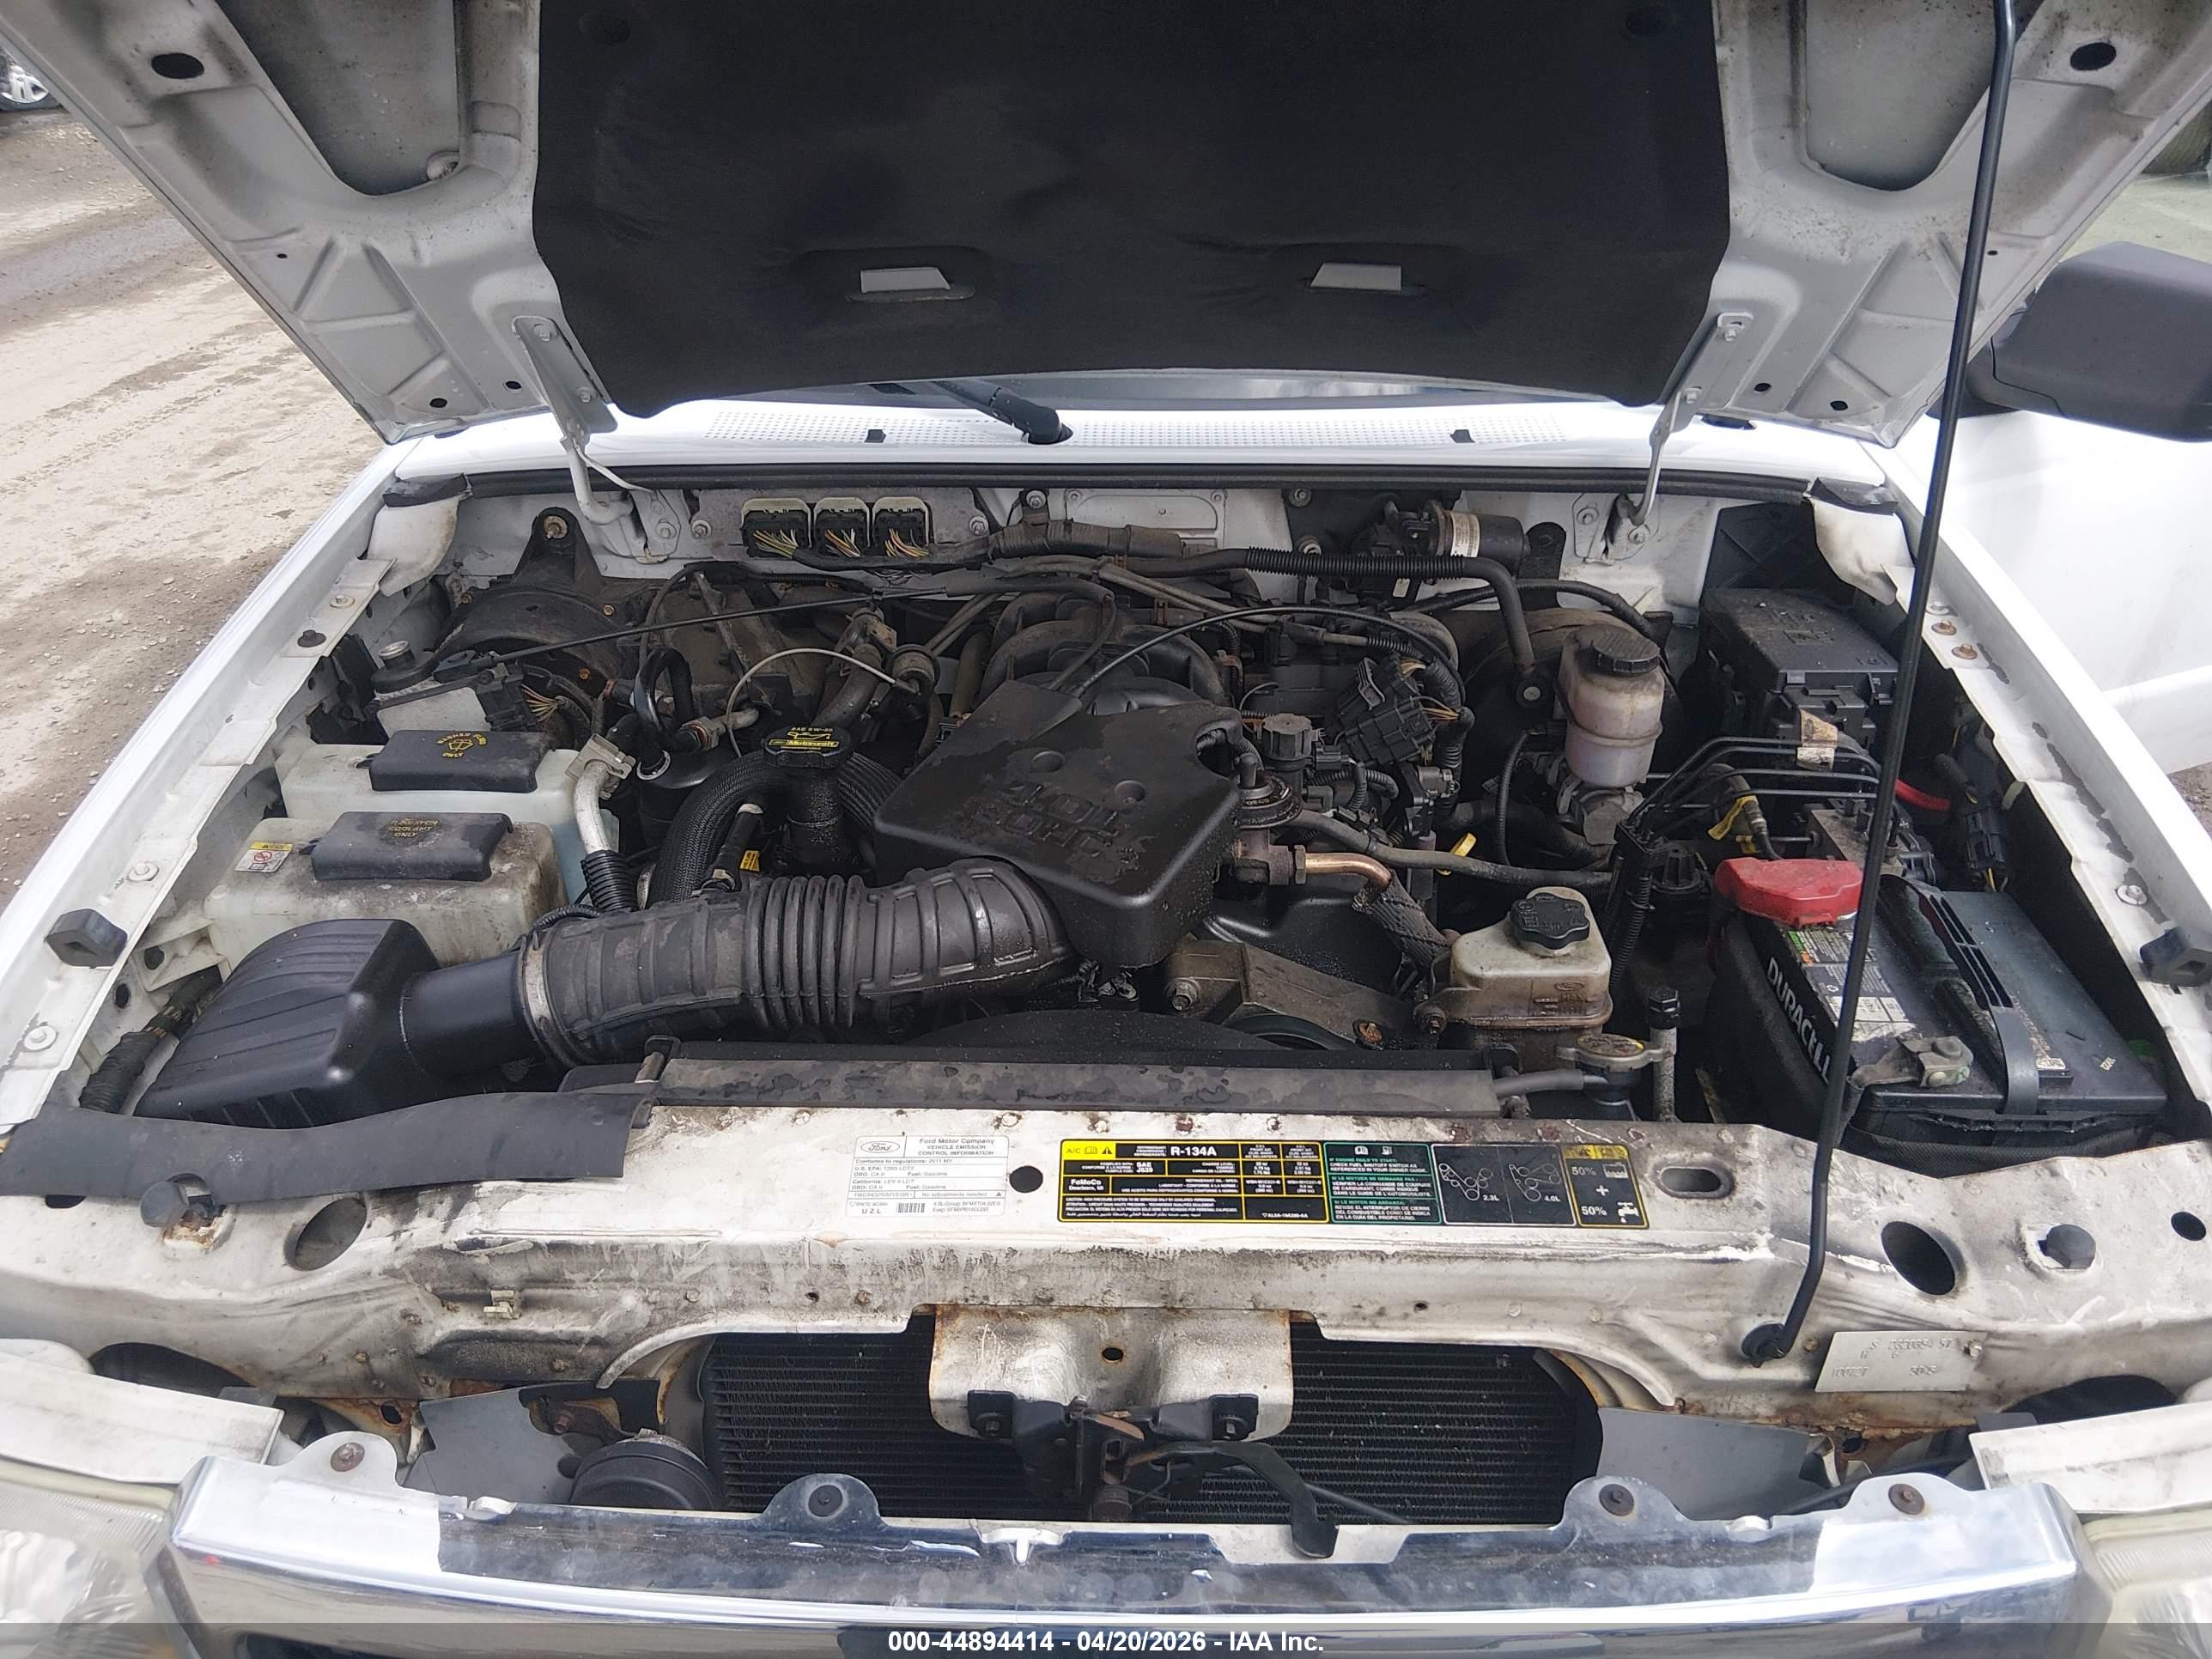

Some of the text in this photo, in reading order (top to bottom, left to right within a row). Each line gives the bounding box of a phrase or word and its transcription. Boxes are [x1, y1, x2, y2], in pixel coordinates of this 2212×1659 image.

[1767, 957, 1831, 1085] DURACELL
[868, 1143, 892, 1151] Ford
[1170, 1146, 1217, 1156] R-134A
[1571, 1167, 1597, 1176] 50%
[1581, 1206, 1608, 1216] 50%
